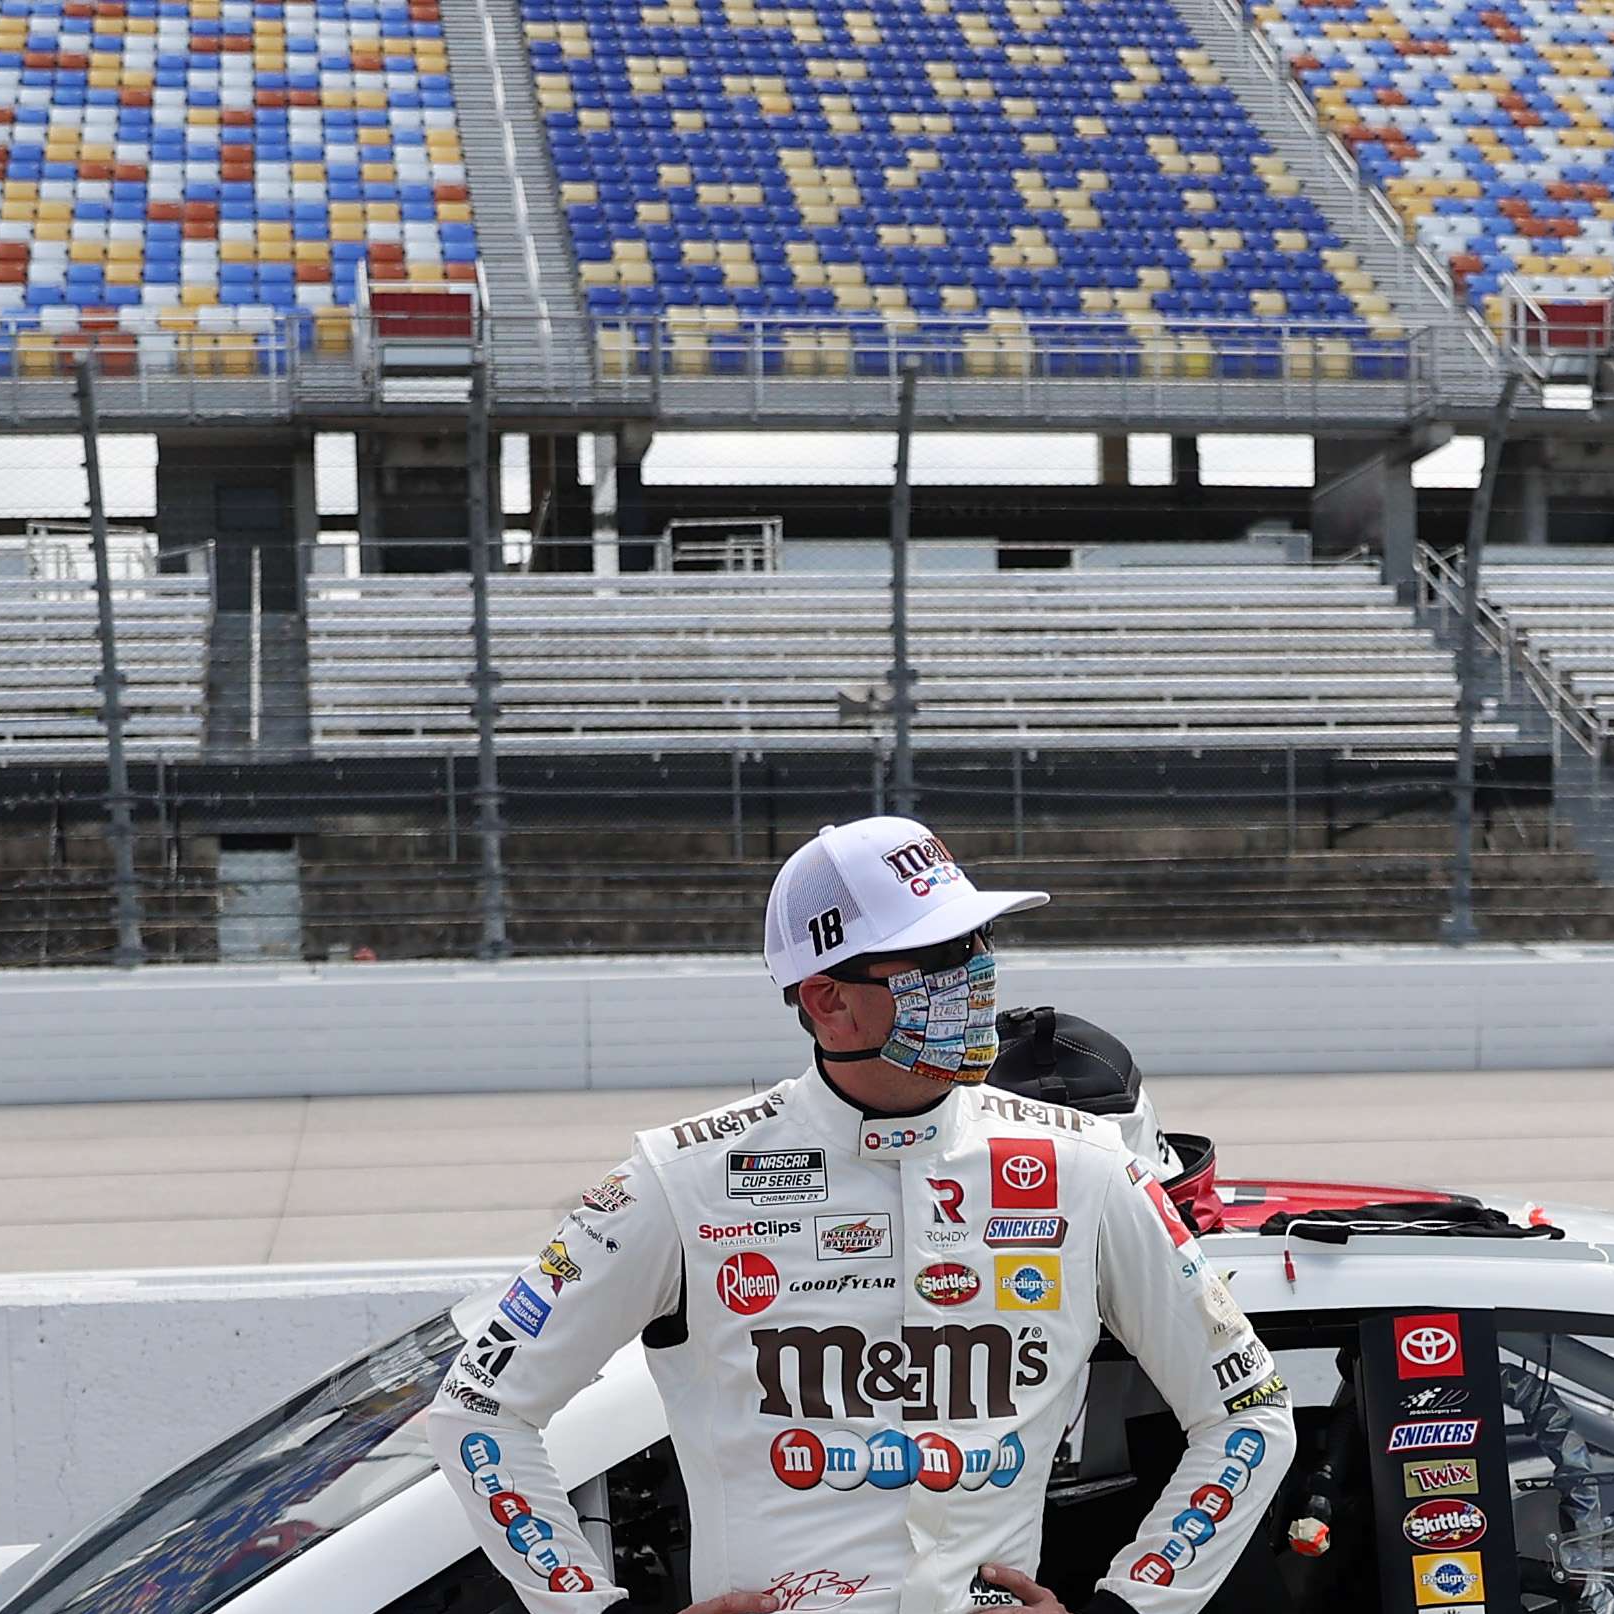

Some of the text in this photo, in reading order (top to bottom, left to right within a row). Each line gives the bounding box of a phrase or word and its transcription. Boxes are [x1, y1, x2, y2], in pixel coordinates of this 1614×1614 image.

[808, 908, 844, 956] 18
[758, 1155, 809, 1170] NASCAR
[742, 1173, 812, 1188] CUP SERIES
[760, 1193, 806, 1203] CHAMPION
[822, 1228, 886, 1241] INTERSTATE
[925, 1231, 970, 1242] ROWDY
[989, 1219, 1057, 1238] SNICKERS
[719, 1236, 779, 1248] HAIRCUTS
[824, 1238, 882, 1250] BATTERIES
[723, 1253, 778, 1307] Rheem
[789, 1275, 896, 1293] GOODYEAR
[922, 1273, 978, 1293] Skittles
[1002, 1277, 1055, 1292] Pedigree
[460, 1353, 495, 1388] Cessna
[1231, 1374, 1285, 1411] STANLE
[1392, 1422, 1475, 1448] SNICKERS
[1411, 1463, 1474, 1491] Twix
[1411, 1512, 1482, 1536] Skittles
[1422, 1572, 1478, 1586] Pedigree
[971, 1594, 1013, 1606] TOOLS
